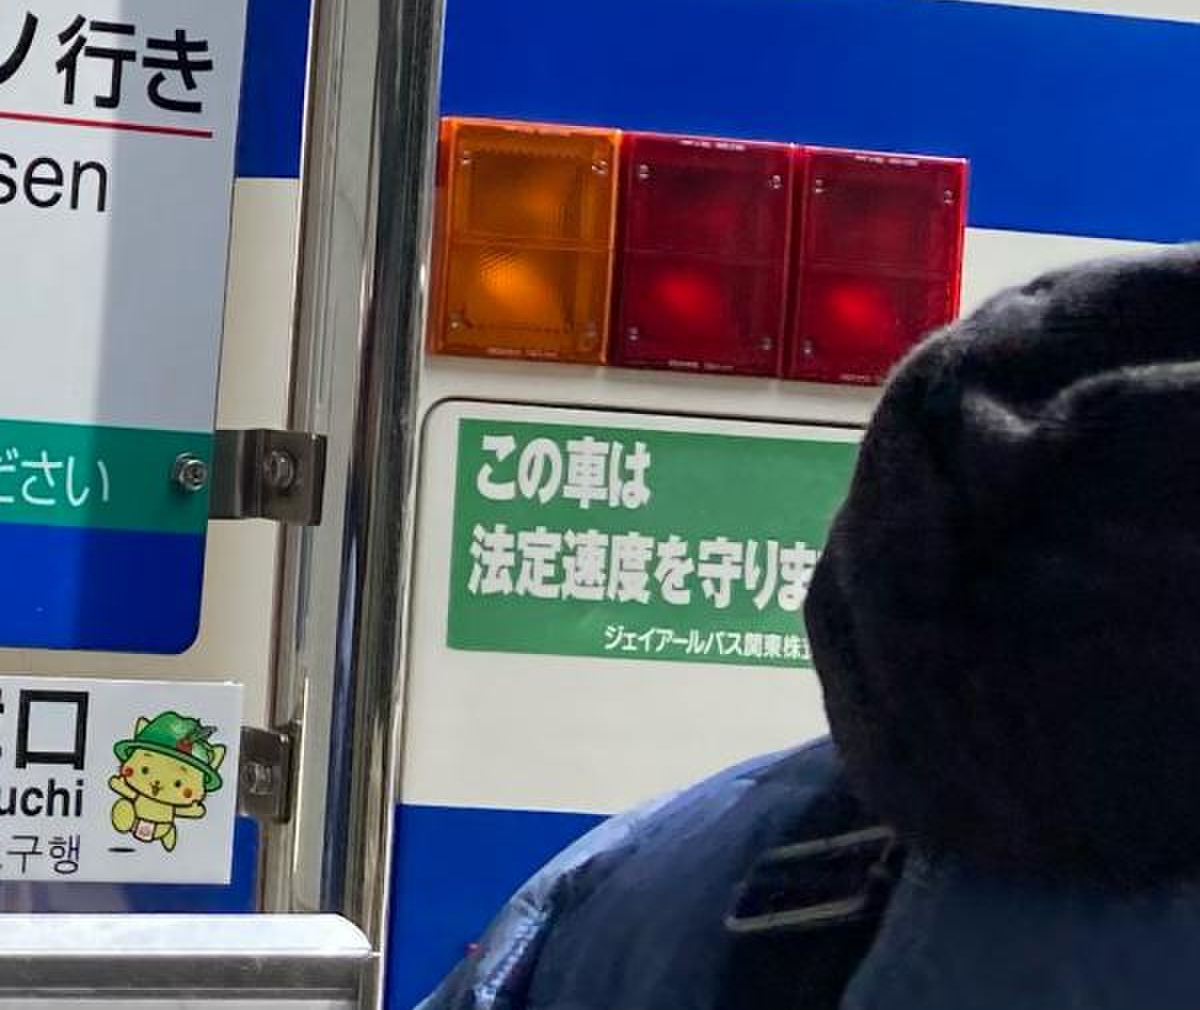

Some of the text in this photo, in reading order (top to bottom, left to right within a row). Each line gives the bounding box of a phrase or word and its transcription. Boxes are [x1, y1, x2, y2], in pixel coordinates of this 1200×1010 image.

[475, 434, 651, 510] この車は
[466, 524, 823, 613] 法定速度を守りま
